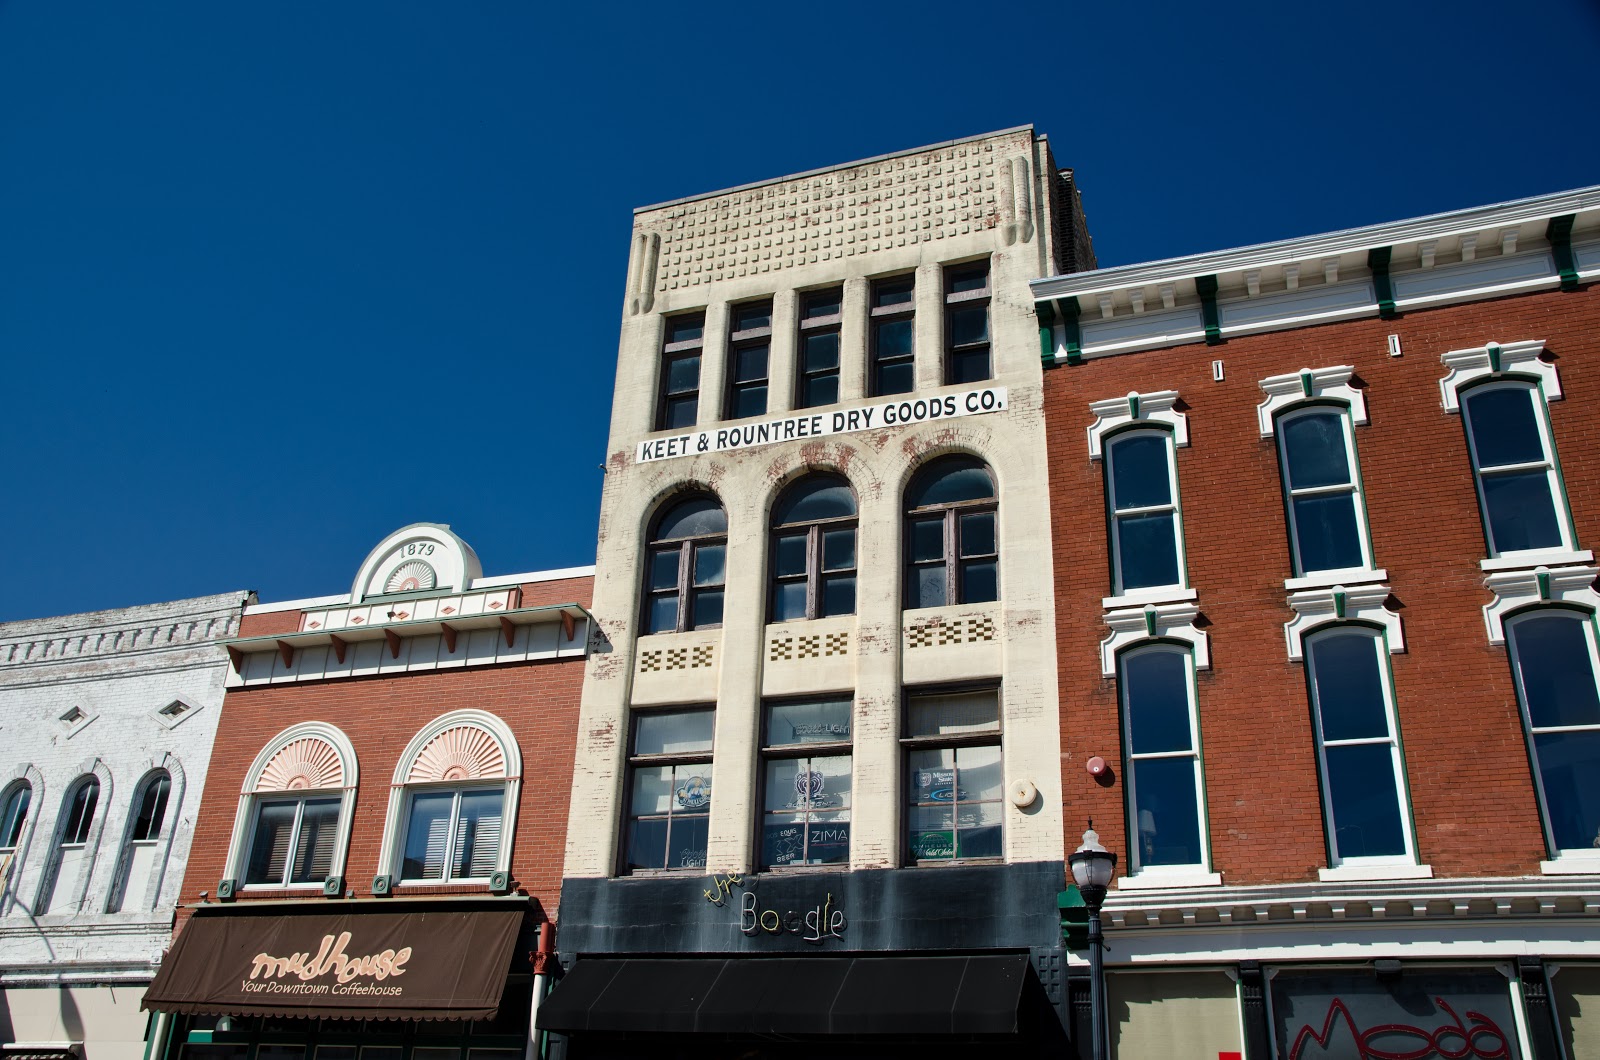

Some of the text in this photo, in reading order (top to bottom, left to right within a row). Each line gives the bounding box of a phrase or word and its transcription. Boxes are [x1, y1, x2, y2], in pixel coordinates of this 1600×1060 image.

[641, 390, 1002, 461] KEET & ROUNTREE DRY GOODS CO.
[400, 543, 435, 559] 1879
[825, 723, 850, 734] LIGHT
[780, 828, 797, 837] EQUIS
[811, 829, 848, 843] ZIMA
[681, 859, 706, 868] LIGHT
[776, 852, 796, 863] BEER
[703, 869, 742, 902] the
[250, 931, 412, 983] mudhouse
[240, 980, 403, 996] Your Downtown Coffeehouse
[1287, 996, 1510, 1060] Moda
